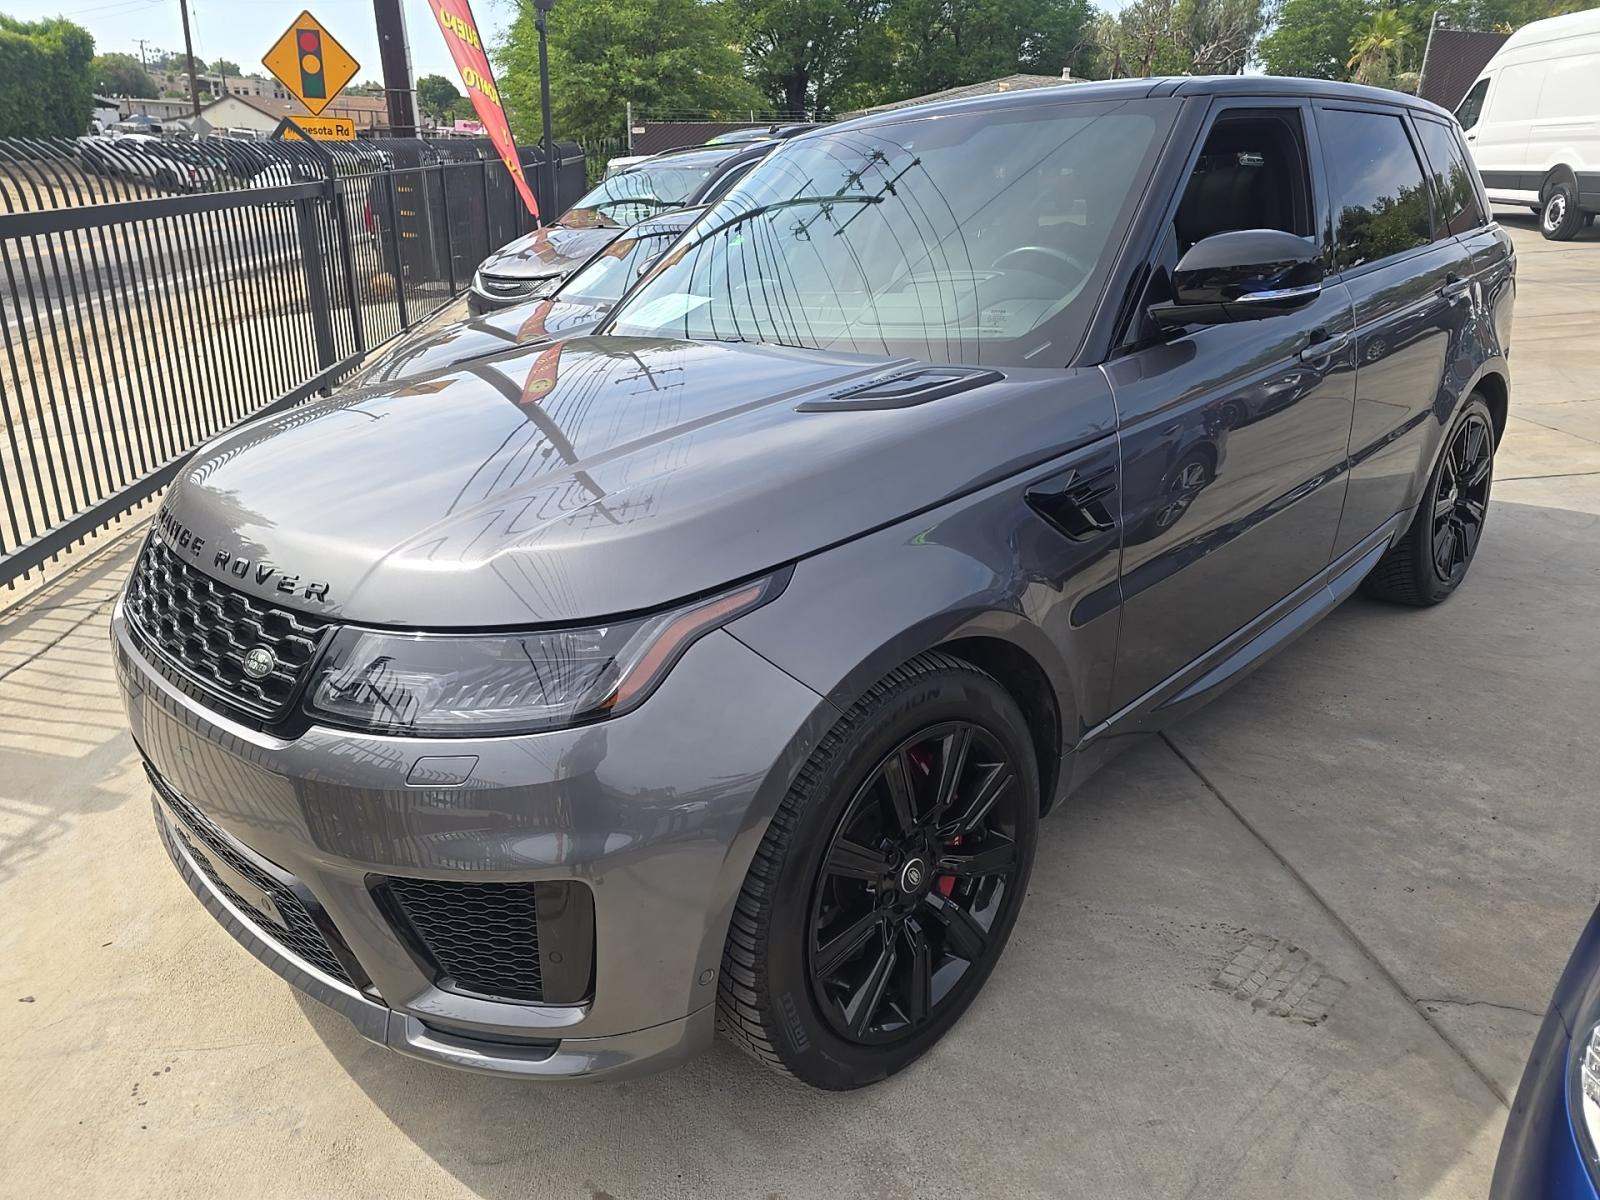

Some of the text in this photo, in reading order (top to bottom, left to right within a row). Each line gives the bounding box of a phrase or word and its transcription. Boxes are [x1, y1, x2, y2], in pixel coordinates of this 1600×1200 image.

[287, 124, 350, 137] nesota Rd
[214, 550, 330, 603] ROVER
